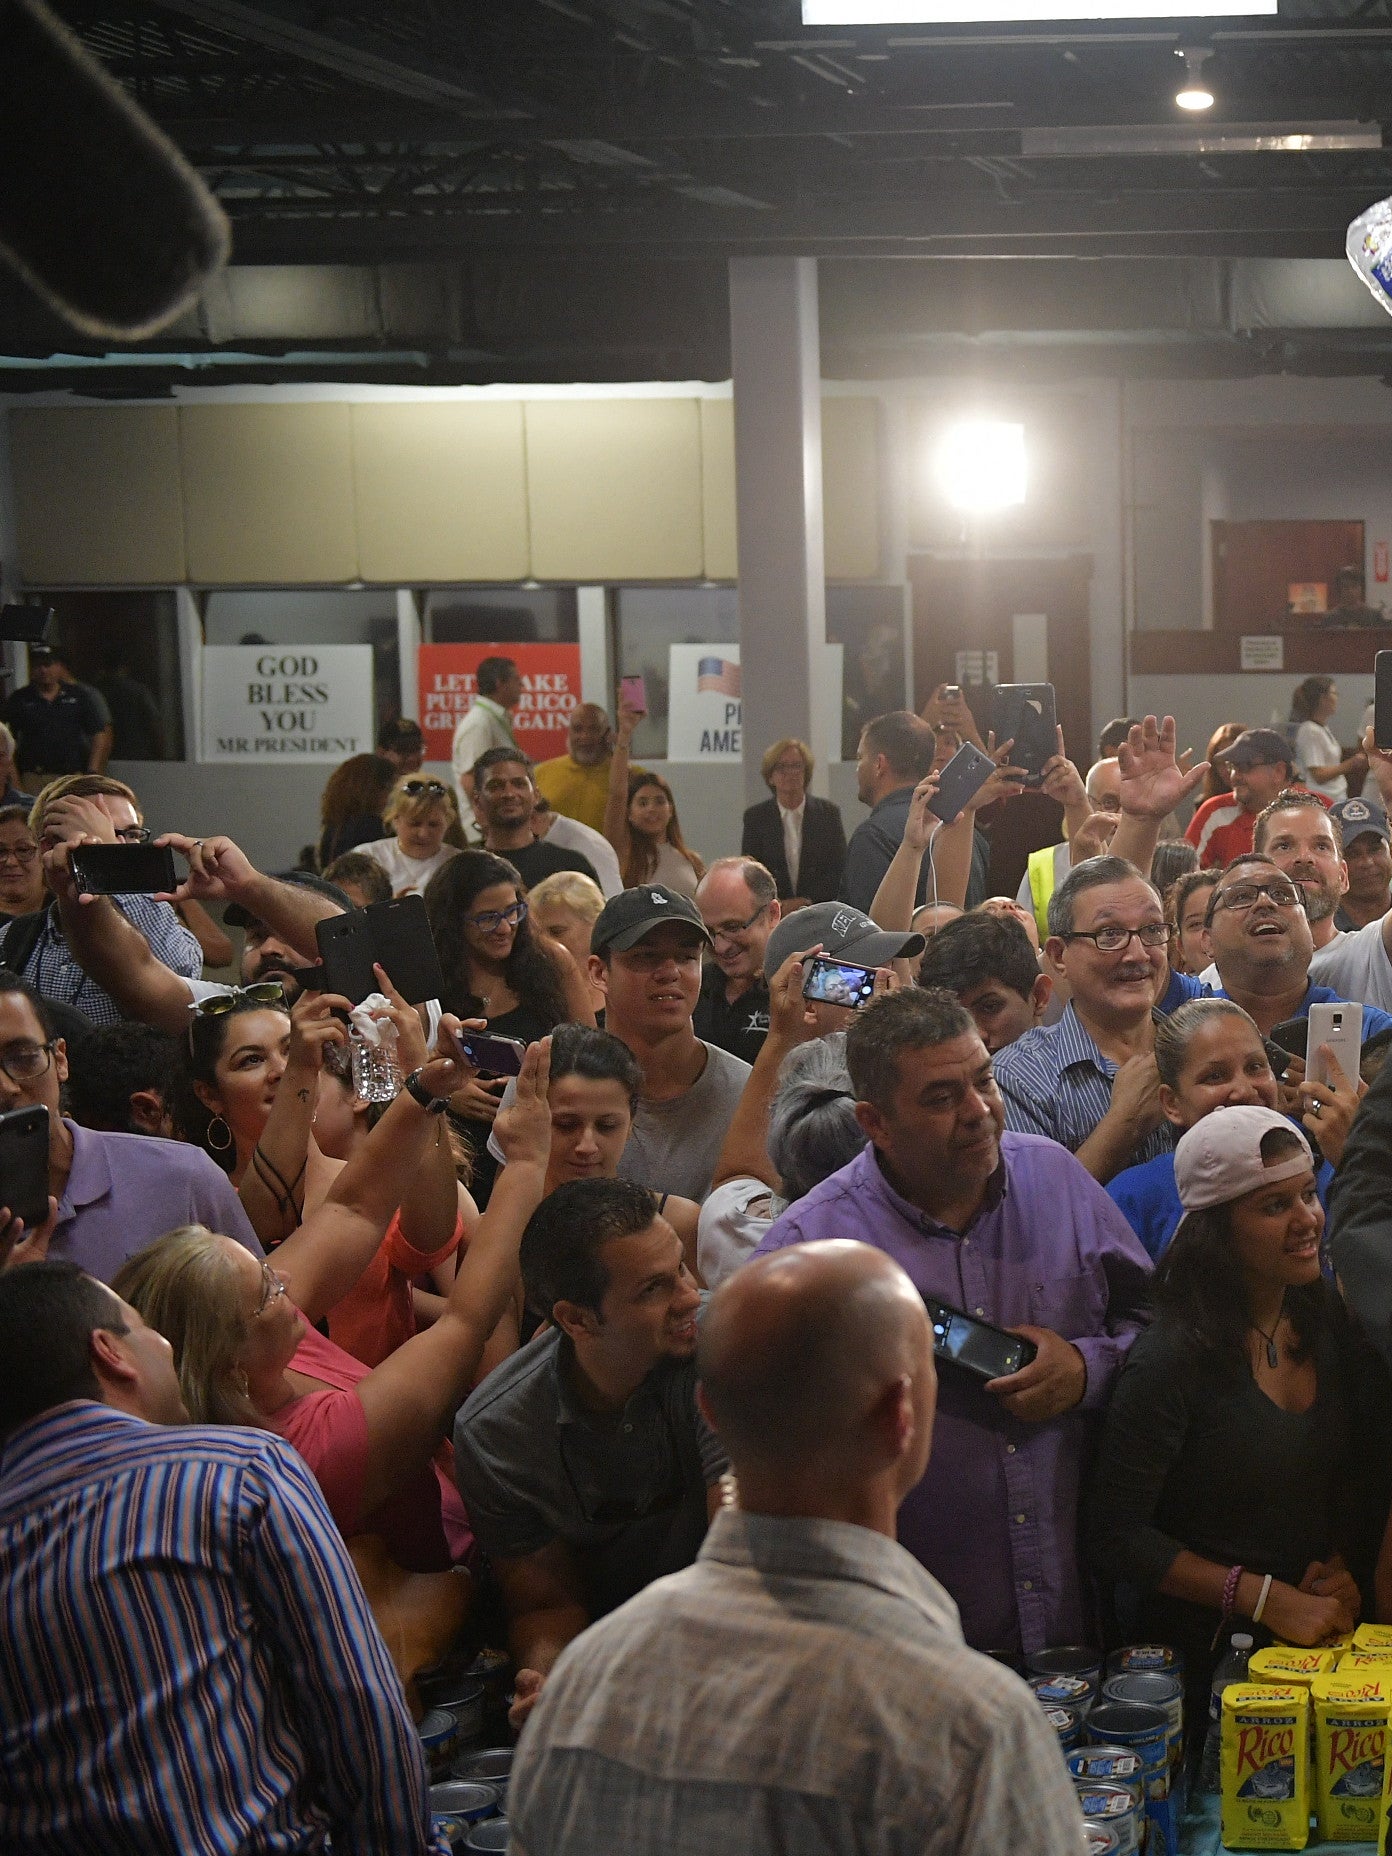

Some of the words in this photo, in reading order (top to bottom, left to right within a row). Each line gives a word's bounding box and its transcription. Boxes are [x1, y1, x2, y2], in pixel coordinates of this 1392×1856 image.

[257, 655, 318, 677] GOD
[247, 682, 328, 704] BLESS
[433, 673, 477, 692] LET
[520, 673, 569, 691] AKE
[518, 693, 577, 712] RICO
[260, 710, 316, 731] YOU
[512, 713, 571, 731] GAIN
[217, 737, 248, 752] MR
[254, 737, 359, 752] PRESIDENT
[1236, 1726, 1294, 1776] Rico
[1329, 1728, 1385, 1775] Rico
